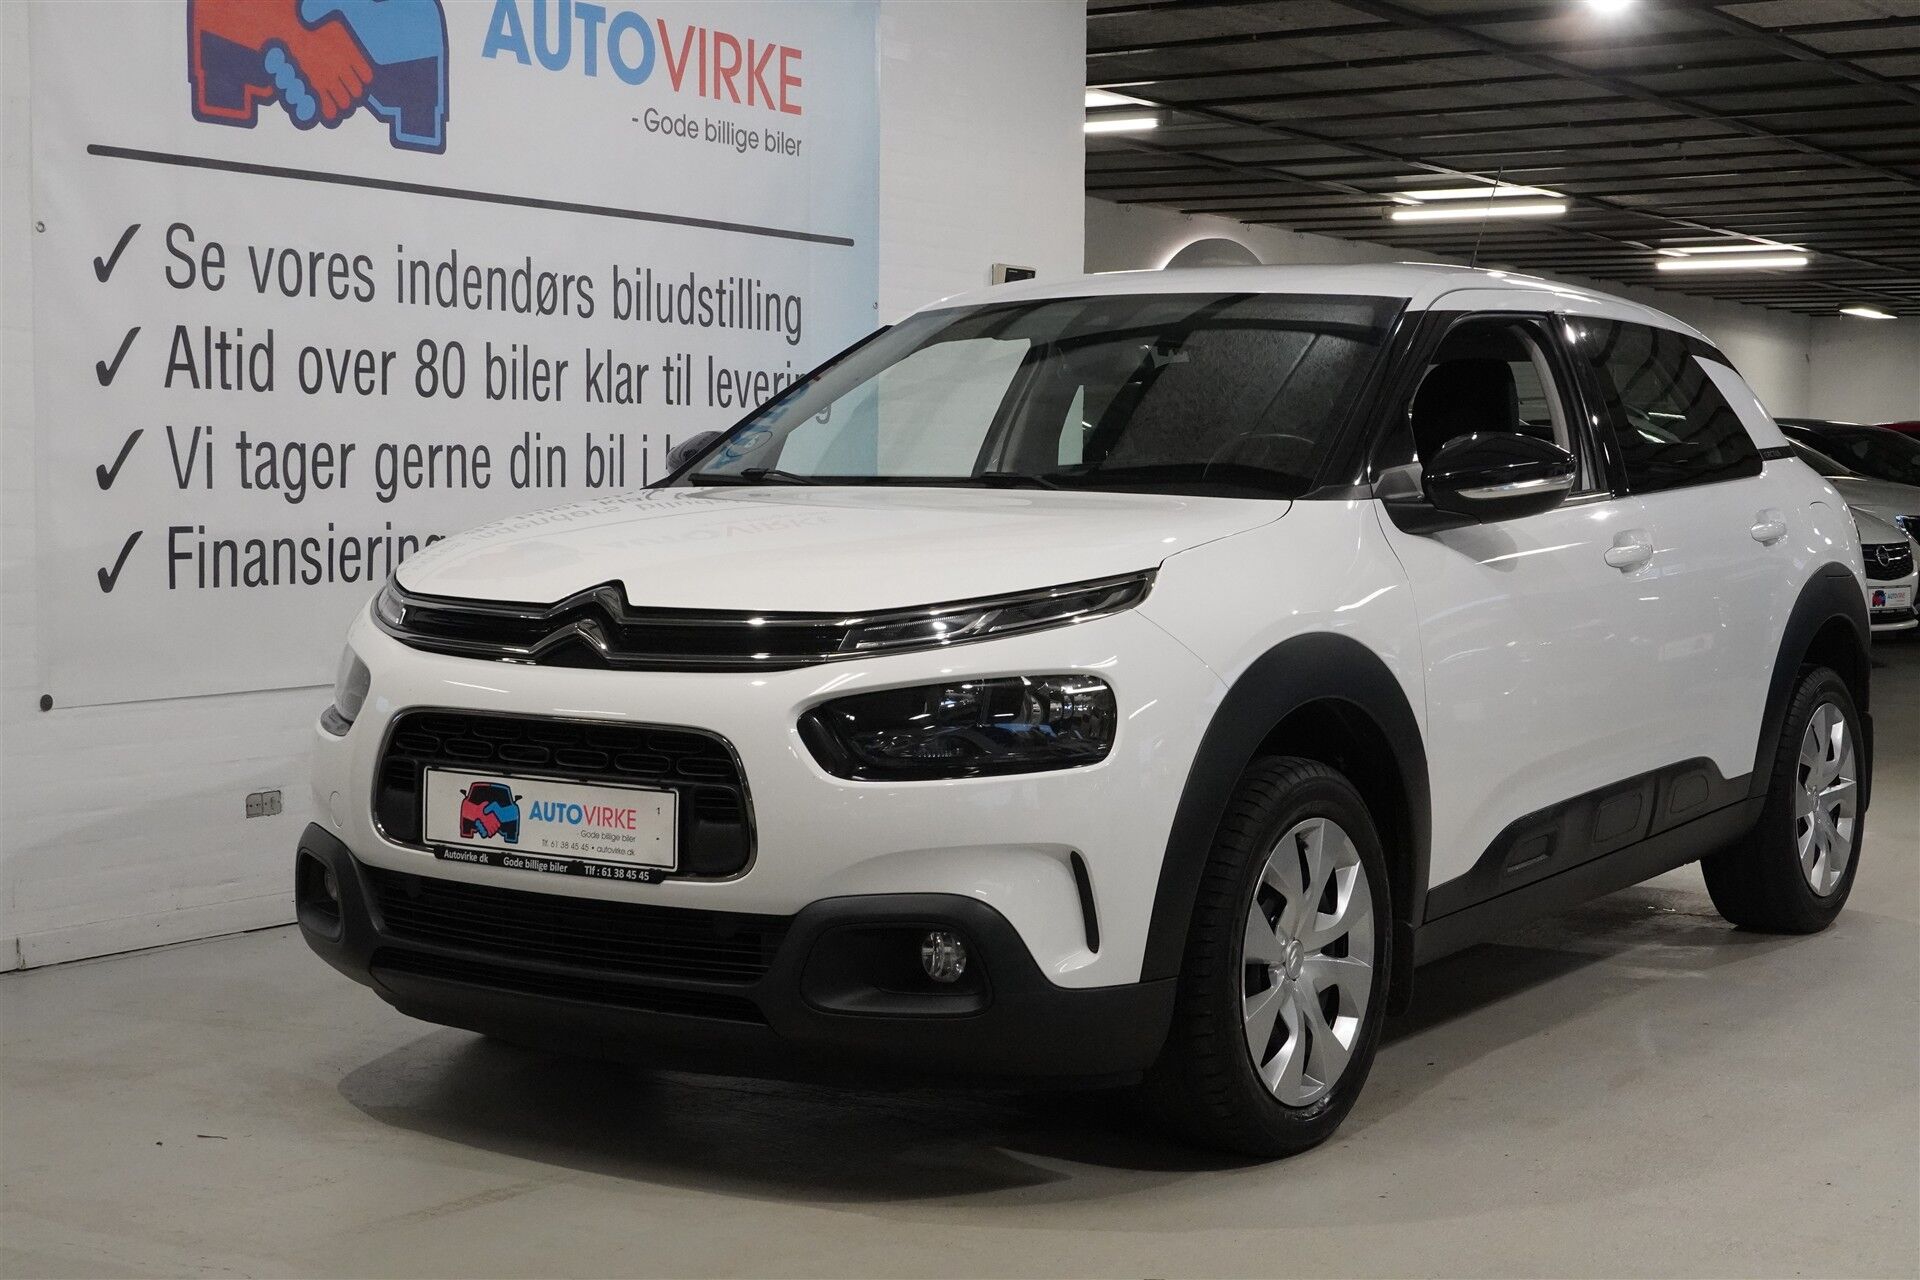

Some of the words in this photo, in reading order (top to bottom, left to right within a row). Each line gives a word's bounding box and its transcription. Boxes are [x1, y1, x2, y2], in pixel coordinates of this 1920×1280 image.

[481, 0, 803, 116] AUTOVIRKE
[643, 107, 699, 139] Gode
[705, 118, 759, 153] billige
[764, 128, 802, 157] biler
[165, 222, 226, 292] Se
[248, 245, 376, 303] vores
[397, 244, 595, 319] indendørs
[613, 264, 802, 346] biludstilling
[164, 325, 275, 393] Altid
[298, 346, 397, 396] over
[415, 338, 466, 399] 80
[485, 341, 569, 401] biler
[585, 348, 650, 405] klar
[662, 353, 692, 406] til
[165, 425, 213, 490] Vi
[235, 430, 356, 505] tager
[375, 441, 492, 504] gerne
[510, 431, 567, 490] din
[585, 432, 626, 489] bil
[642, 433, 649, 489] i
[167, 521, 447, 590] Finansierin
[528, 800, 637, 830] AUTOVIRKE
[580, 829, 600, 840] Gode
[443, 849, 478, 862] Autovirke
[503, 857, 524, 868] Gode
[525, 860, 548, 873] billige
[549, 863, 569, 873] biler
[601, 867, 612, 877] 61
[613, 868, 625, 879] 38
[625, 869, 637, 880] 45
[638, 871, 650, 881] 45
